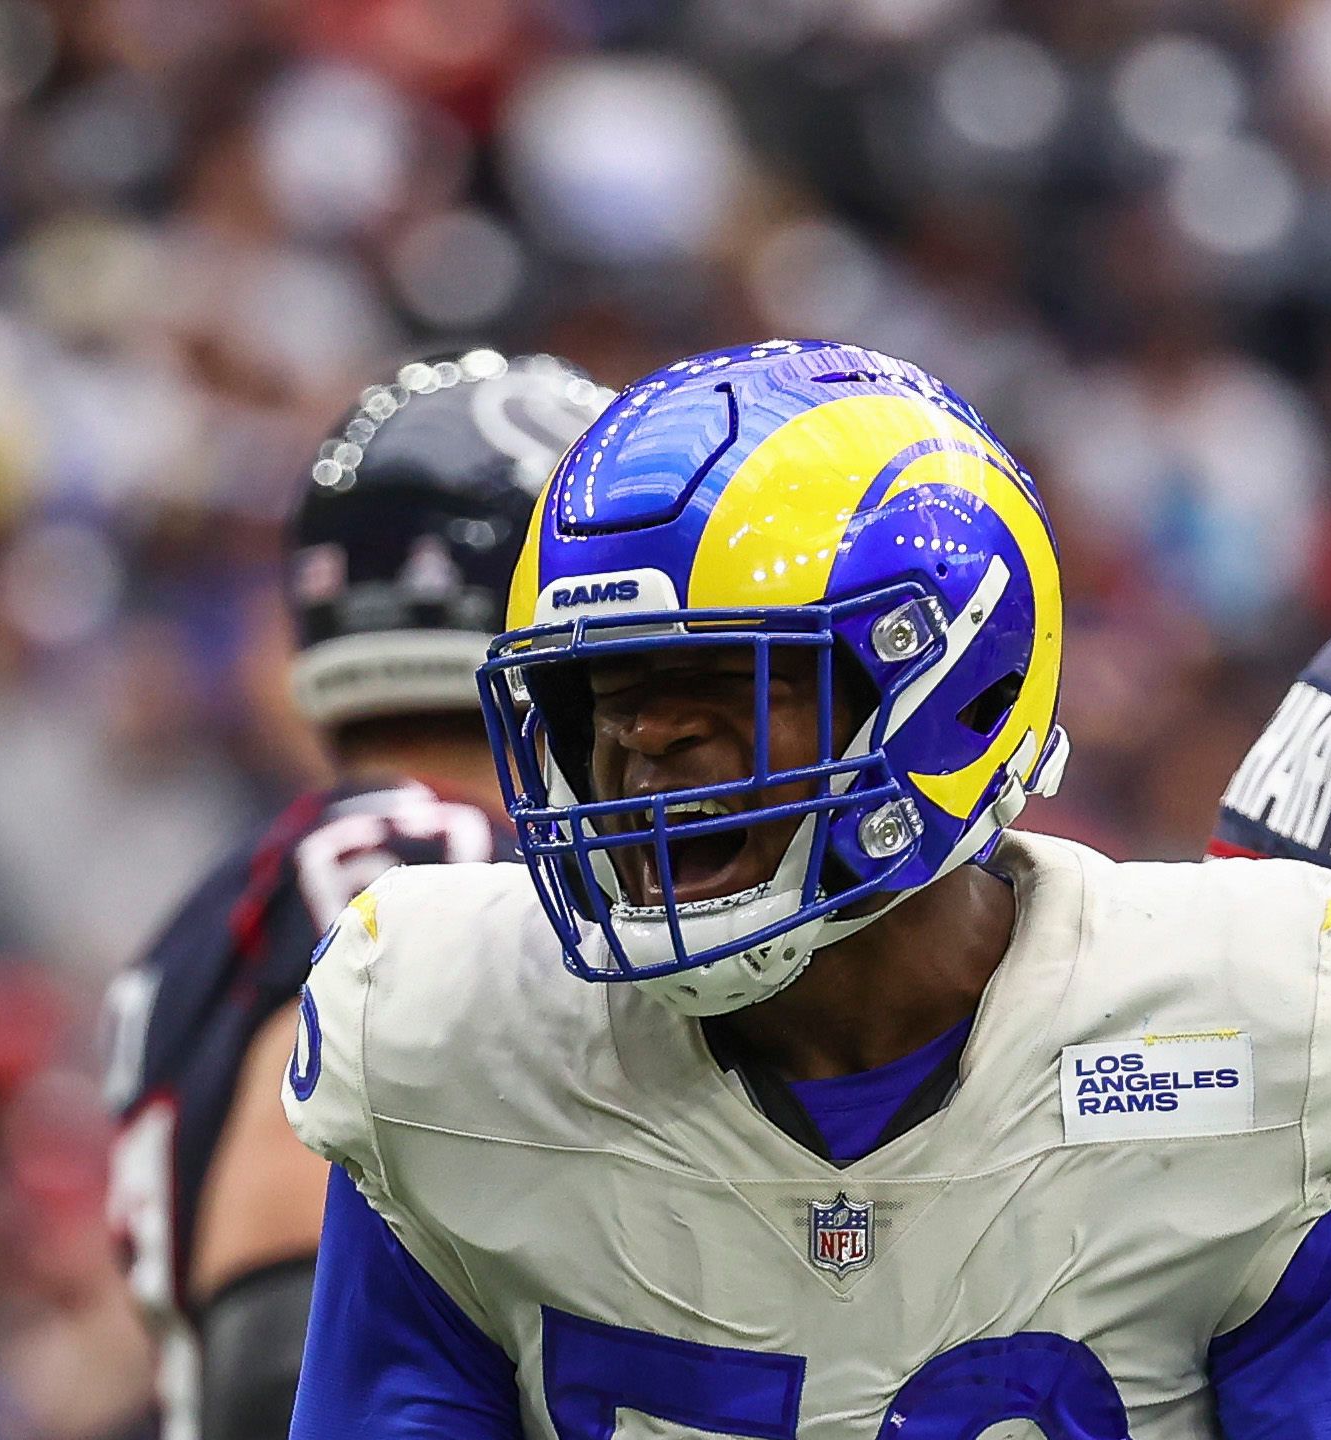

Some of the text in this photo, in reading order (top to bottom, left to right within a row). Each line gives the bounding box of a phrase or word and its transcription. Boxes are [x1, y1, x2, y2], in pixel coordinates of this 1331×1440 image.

[552, 579, 640, 610] RAMS
[1075, 1053, 1144, 1077] LOS
[1076, 1068, 1239, 1096] ANGELES
[1078, 1092, 1178, 1116] RAMS
[819, 1230, 864, 1263] NFL
